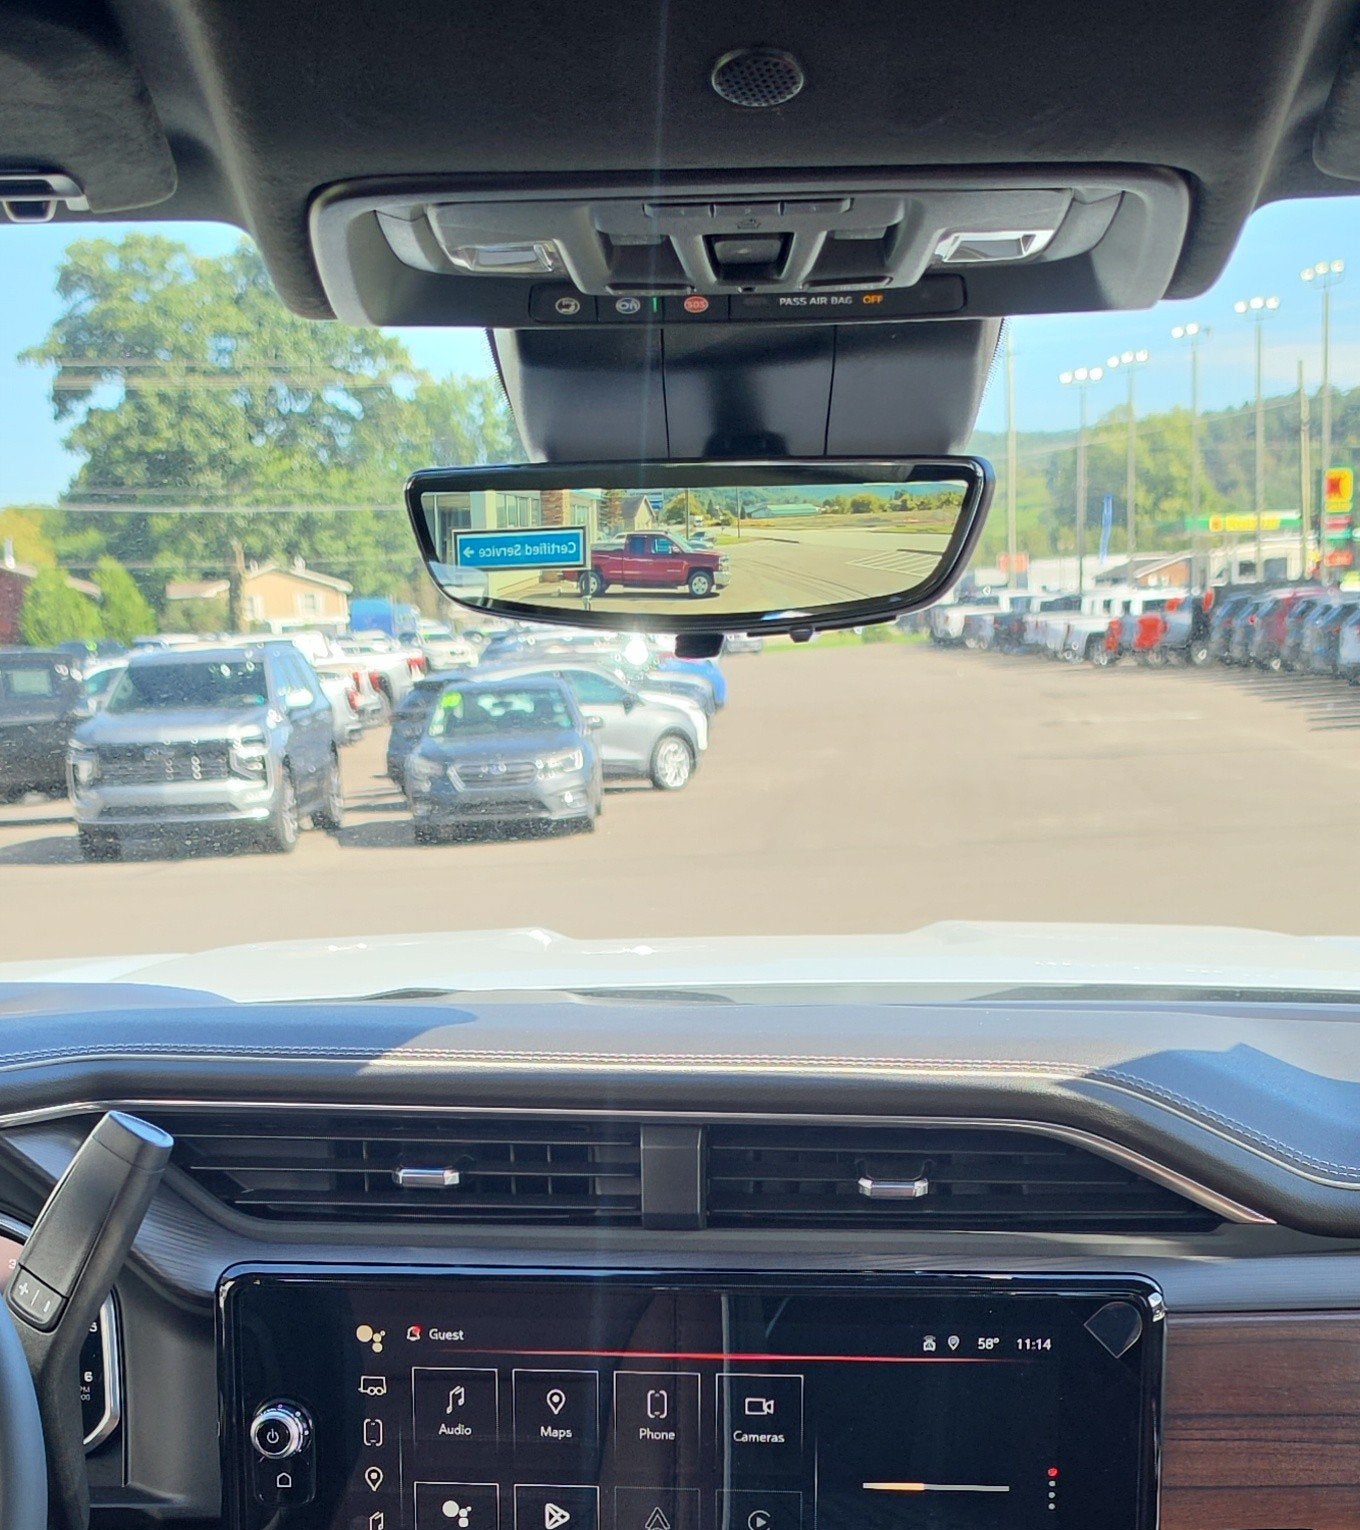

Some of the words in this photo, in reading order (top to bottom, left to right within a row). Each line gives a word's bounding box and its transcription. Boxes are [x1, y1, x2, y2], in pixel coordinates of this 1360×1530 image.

[779, 297, 807, 306] PASS
[810, 296, 828, 305] AIR
[863, 294, 884, 304] OFF
[429, 1328, 464, 1341] Guest
[1016, 1338, 1052, 1350] 11:14
[439, 1423, 472, 1436] Audio
[540, 1426, 572, 1441] Maps
[639, 1429, 675, 1441] Phone
[733, 1431, 785, 1443] Cameras
